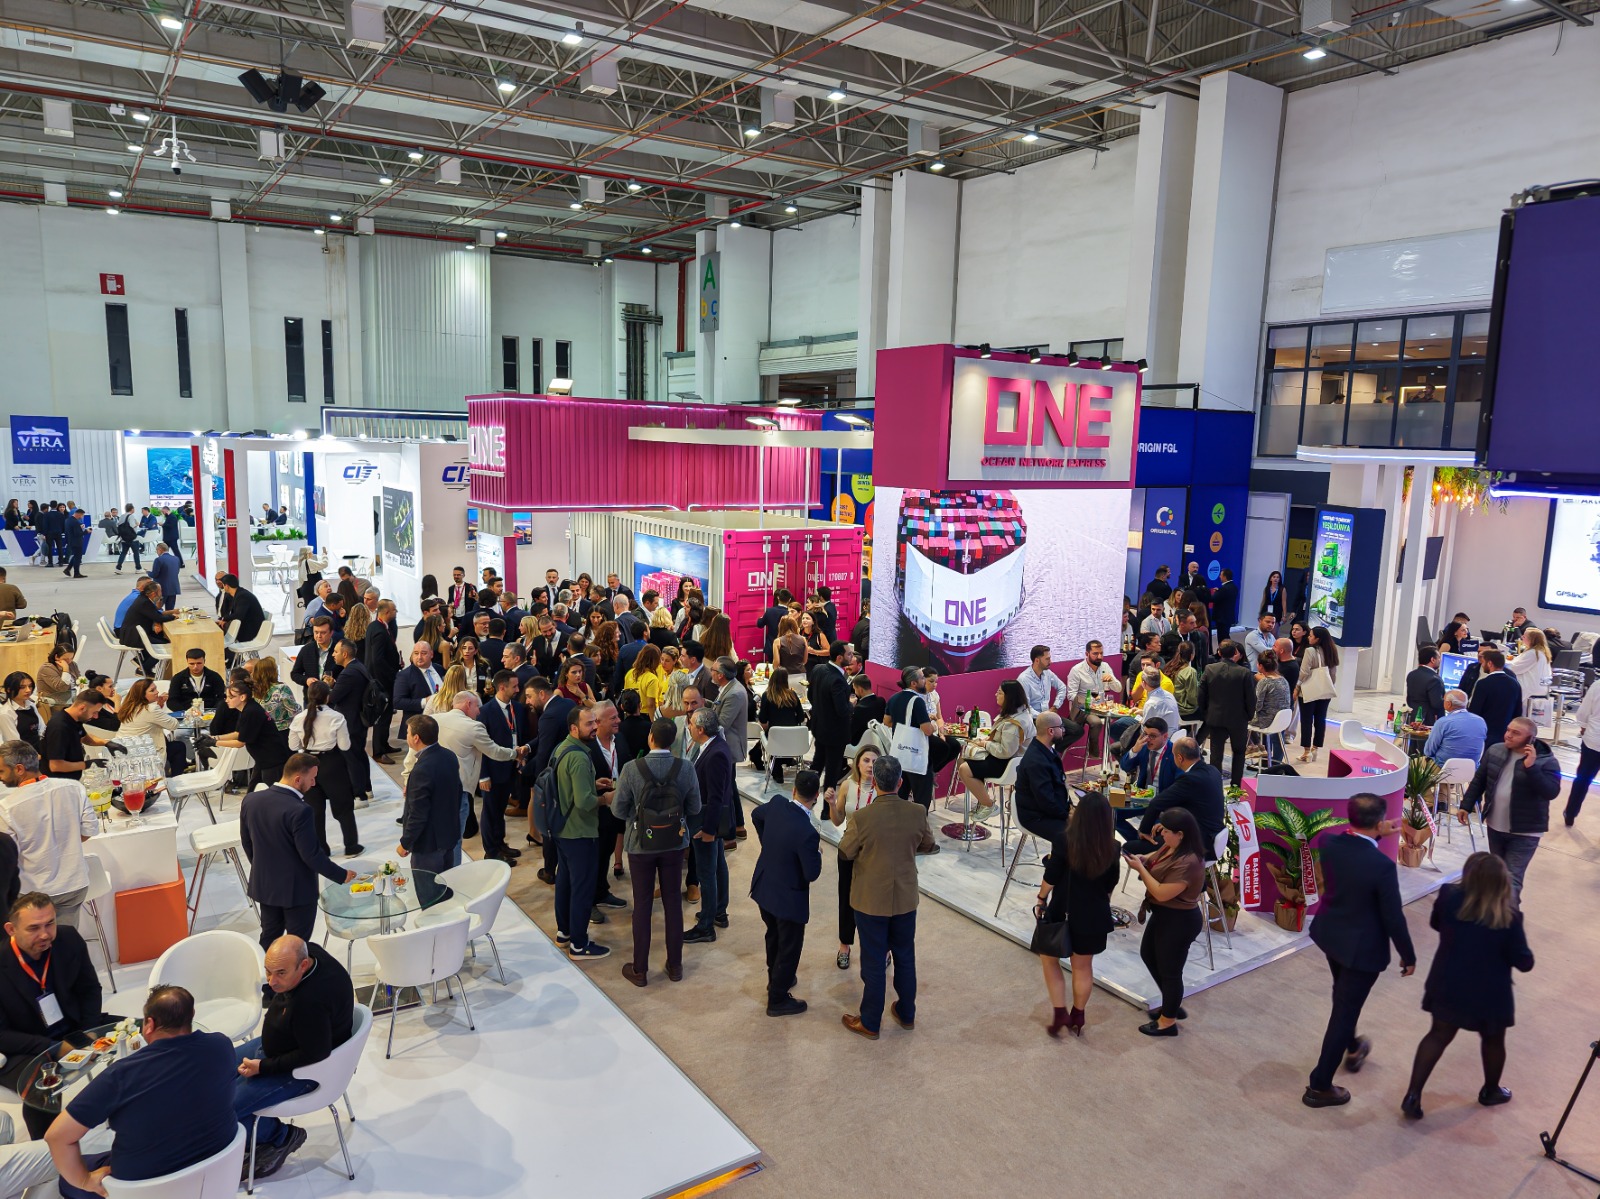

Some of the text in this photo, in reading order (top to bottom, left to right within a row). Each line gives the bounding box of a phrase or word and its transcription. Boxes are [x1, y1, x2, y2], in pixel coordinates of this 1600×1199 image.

[703, 259, 715, 291] A
[984, 376, 1113, 448] ONE
[17, 436, 64, 448] VERA
[468, 426, 505, 467] ONE
[1137, 443, 1178, 454] RIGIN FGL
[981, 457, 1106, 468] OCEAN NETWORK EXPRESS
[945, 597, 987, 627] ONE
[1252, 858, 1260, 900] BAŞARILAR
